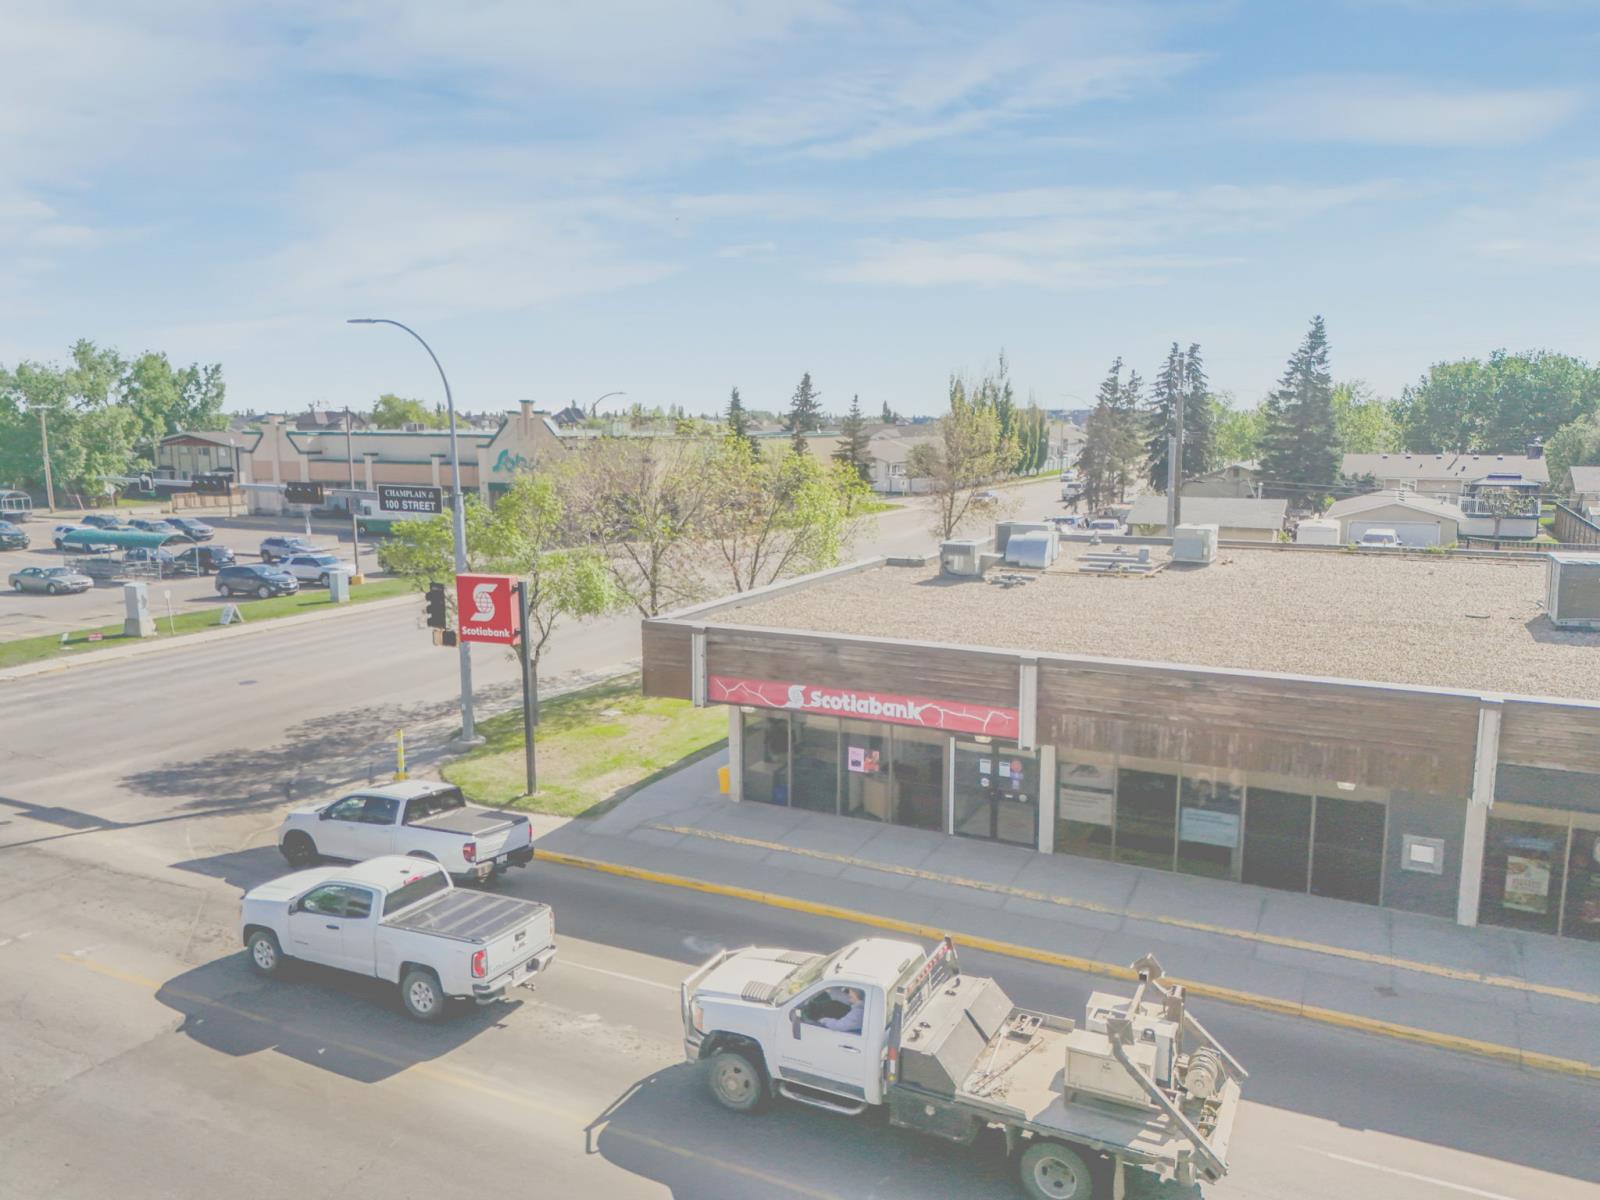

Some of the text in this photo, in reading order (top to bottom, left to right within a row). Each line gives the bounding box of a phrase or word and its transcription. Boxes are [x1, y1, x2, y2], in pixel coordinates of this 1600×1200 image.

[384, 489, 427, 498] CHAMPLAIN
[385, 499, 436, 511] 100 STREET
[462, 626, 510, 638] Scotiabank
[810, 691, 921, 720] Scotiabank
